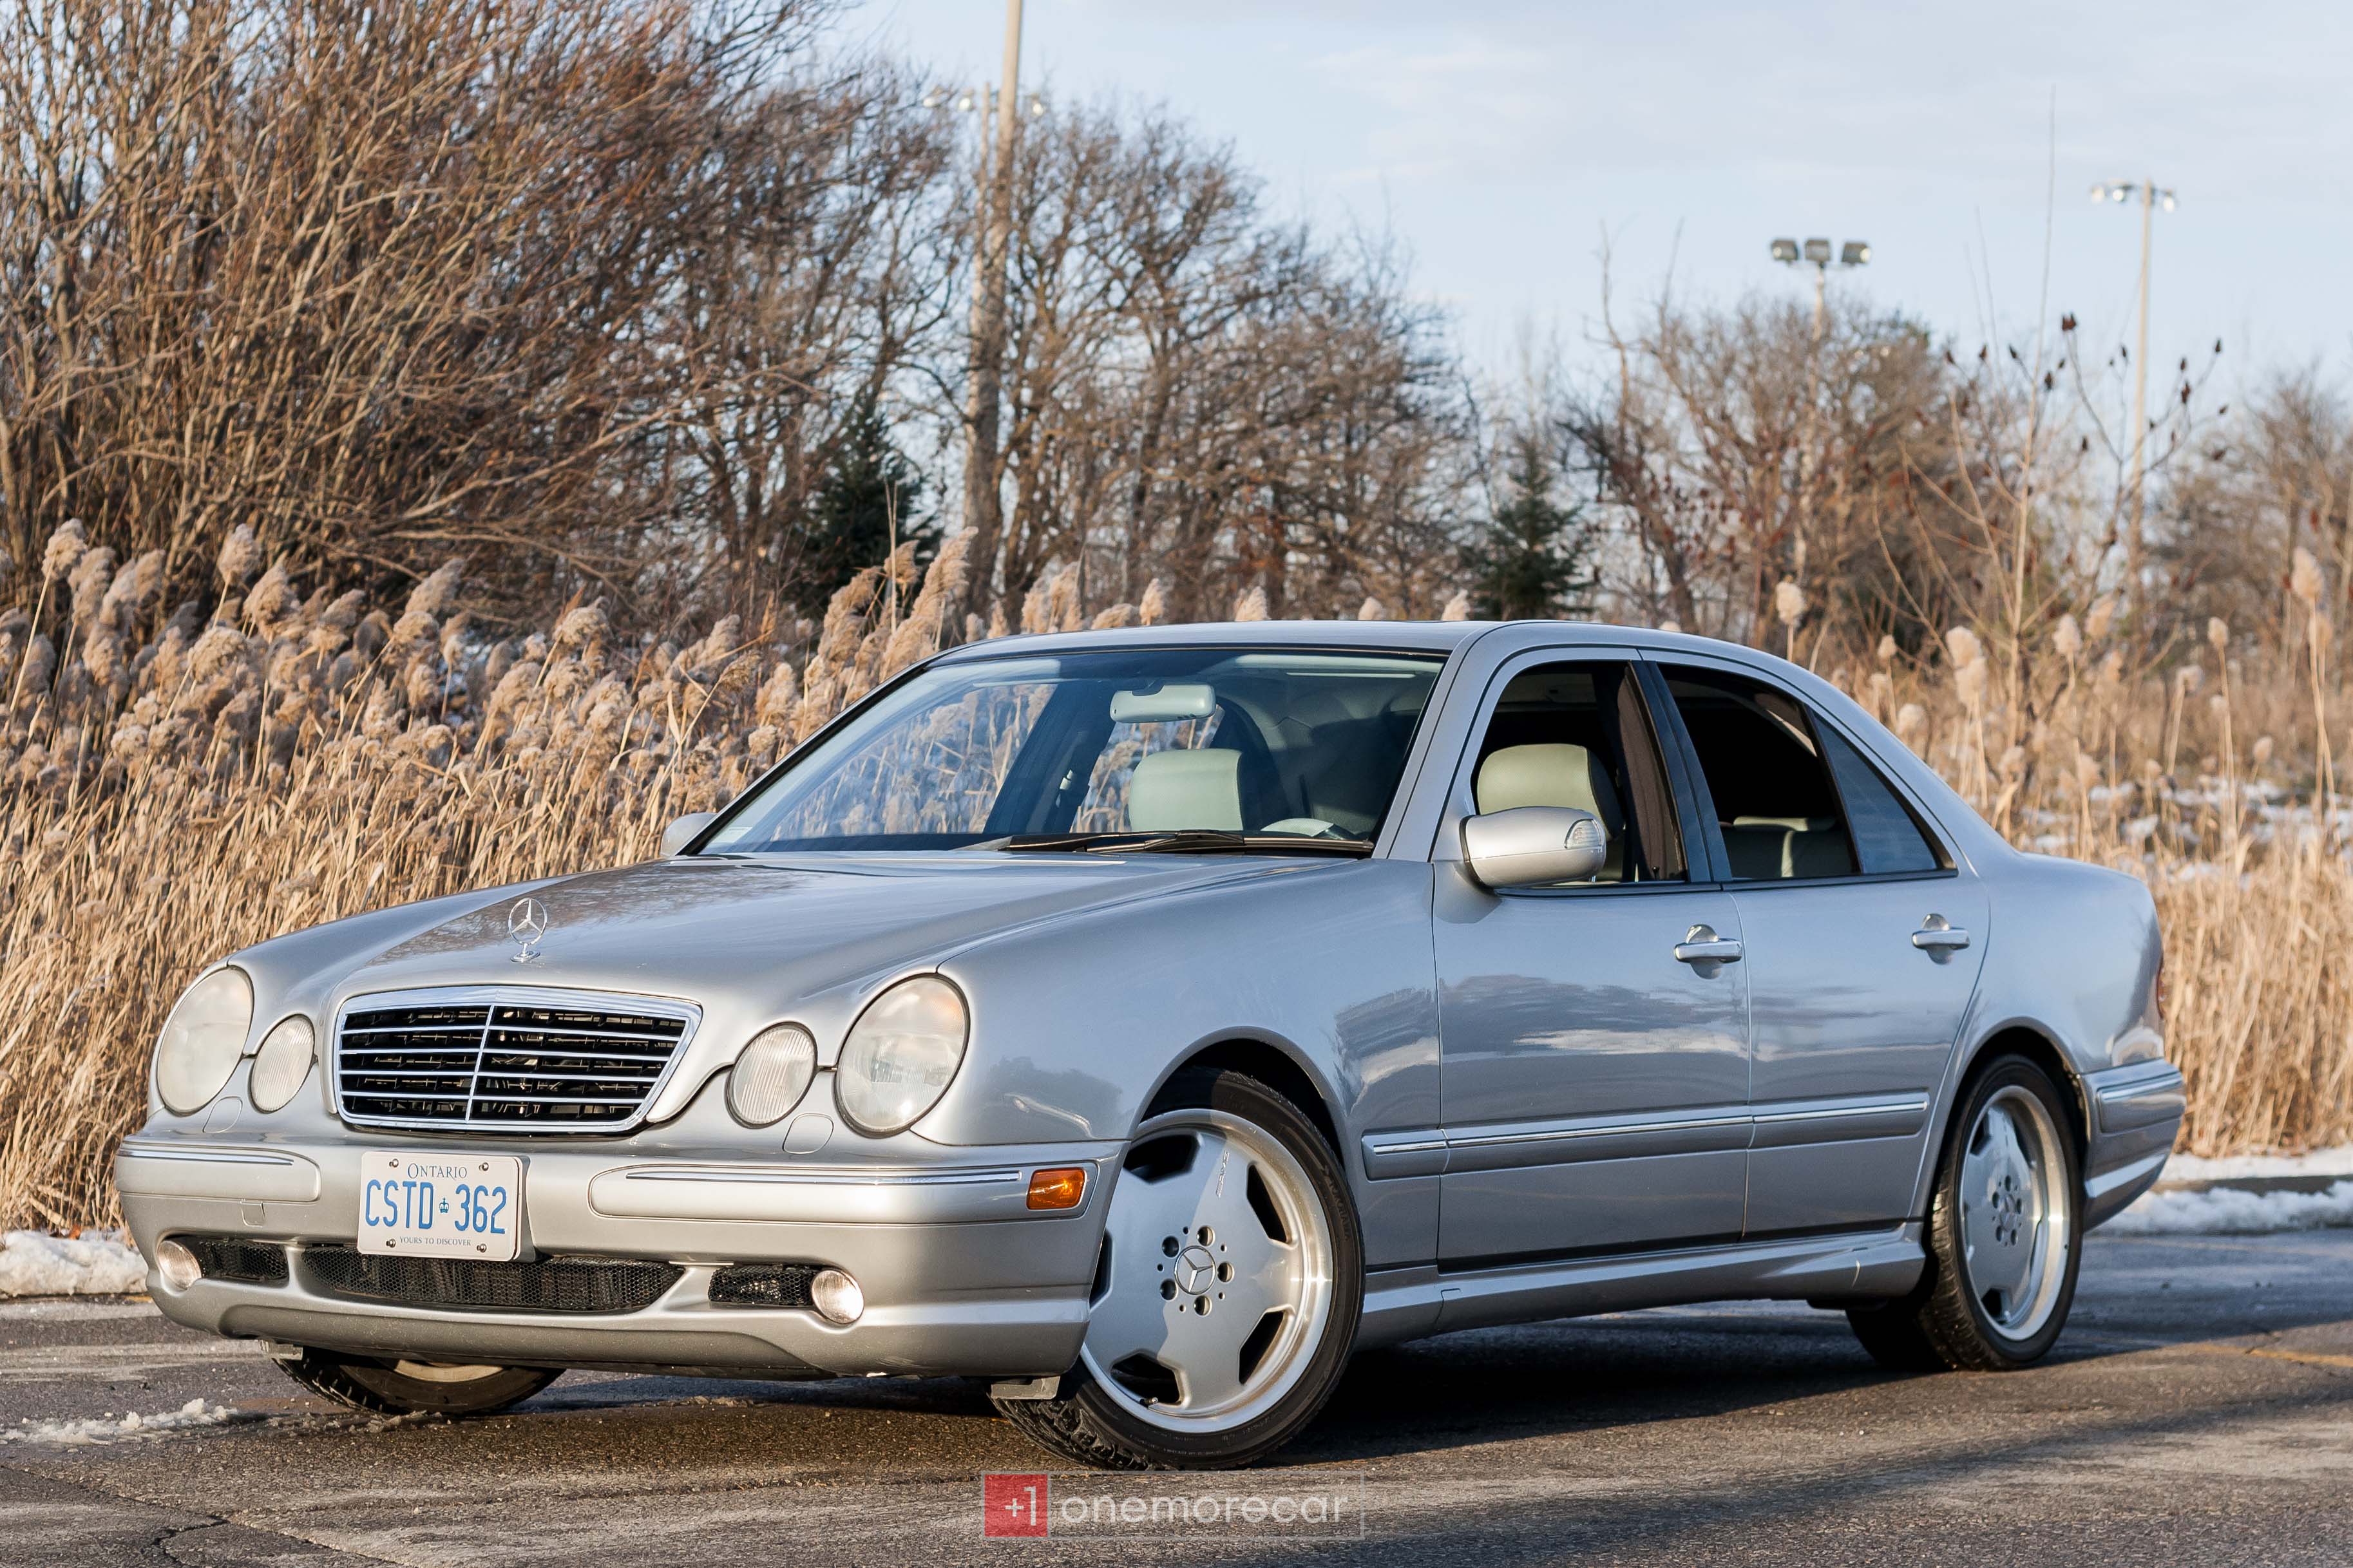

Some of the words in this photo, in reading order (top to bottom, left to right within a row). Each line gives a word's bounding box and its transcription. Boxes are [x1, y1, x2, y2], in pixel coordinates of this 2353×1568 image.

[408, 1163, 468, 1180] ONTARIO
[365, 1179, 434, 1230] CSTD
[454, 1184, 507, 1234] 362
[399, 1236, 423, 1244] YOURS
[424, 1236, 435, 1245] TO
[437, 1238, 472, 1247] DISCOVER
